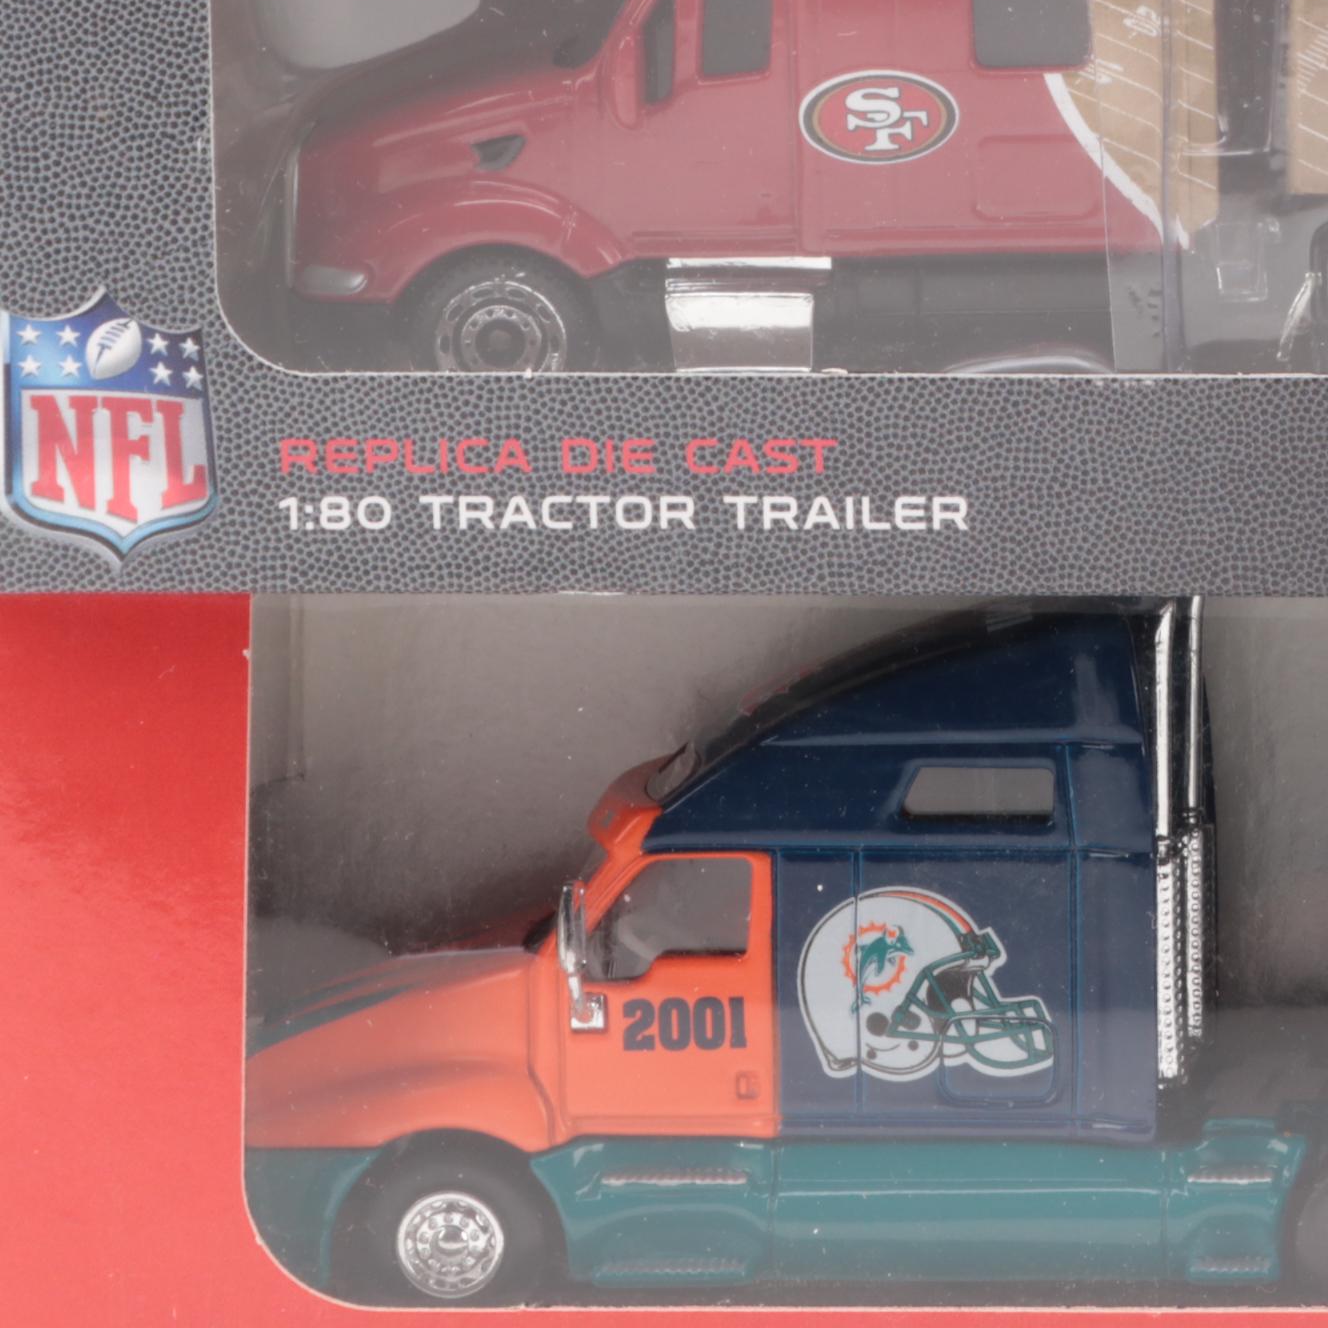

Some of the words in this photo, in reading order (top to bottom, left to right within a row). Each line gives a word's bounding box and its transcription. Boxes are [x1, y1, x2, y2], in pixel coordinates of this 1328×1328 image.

[844, 86, 929, 152] SF
[29, 394, 208, 525] NFL
[280, 438, 533, 473] REPLICA
[561, 438, 656, 474] DIE
[685, 438, 838, 474] CAST
[278, 496, 392, 530] 1:80
[419, 495, 696, 531] TRACTOR
[723, 495, 969, 531] TRAILER
[622, 996, 748, 1051] 2001
